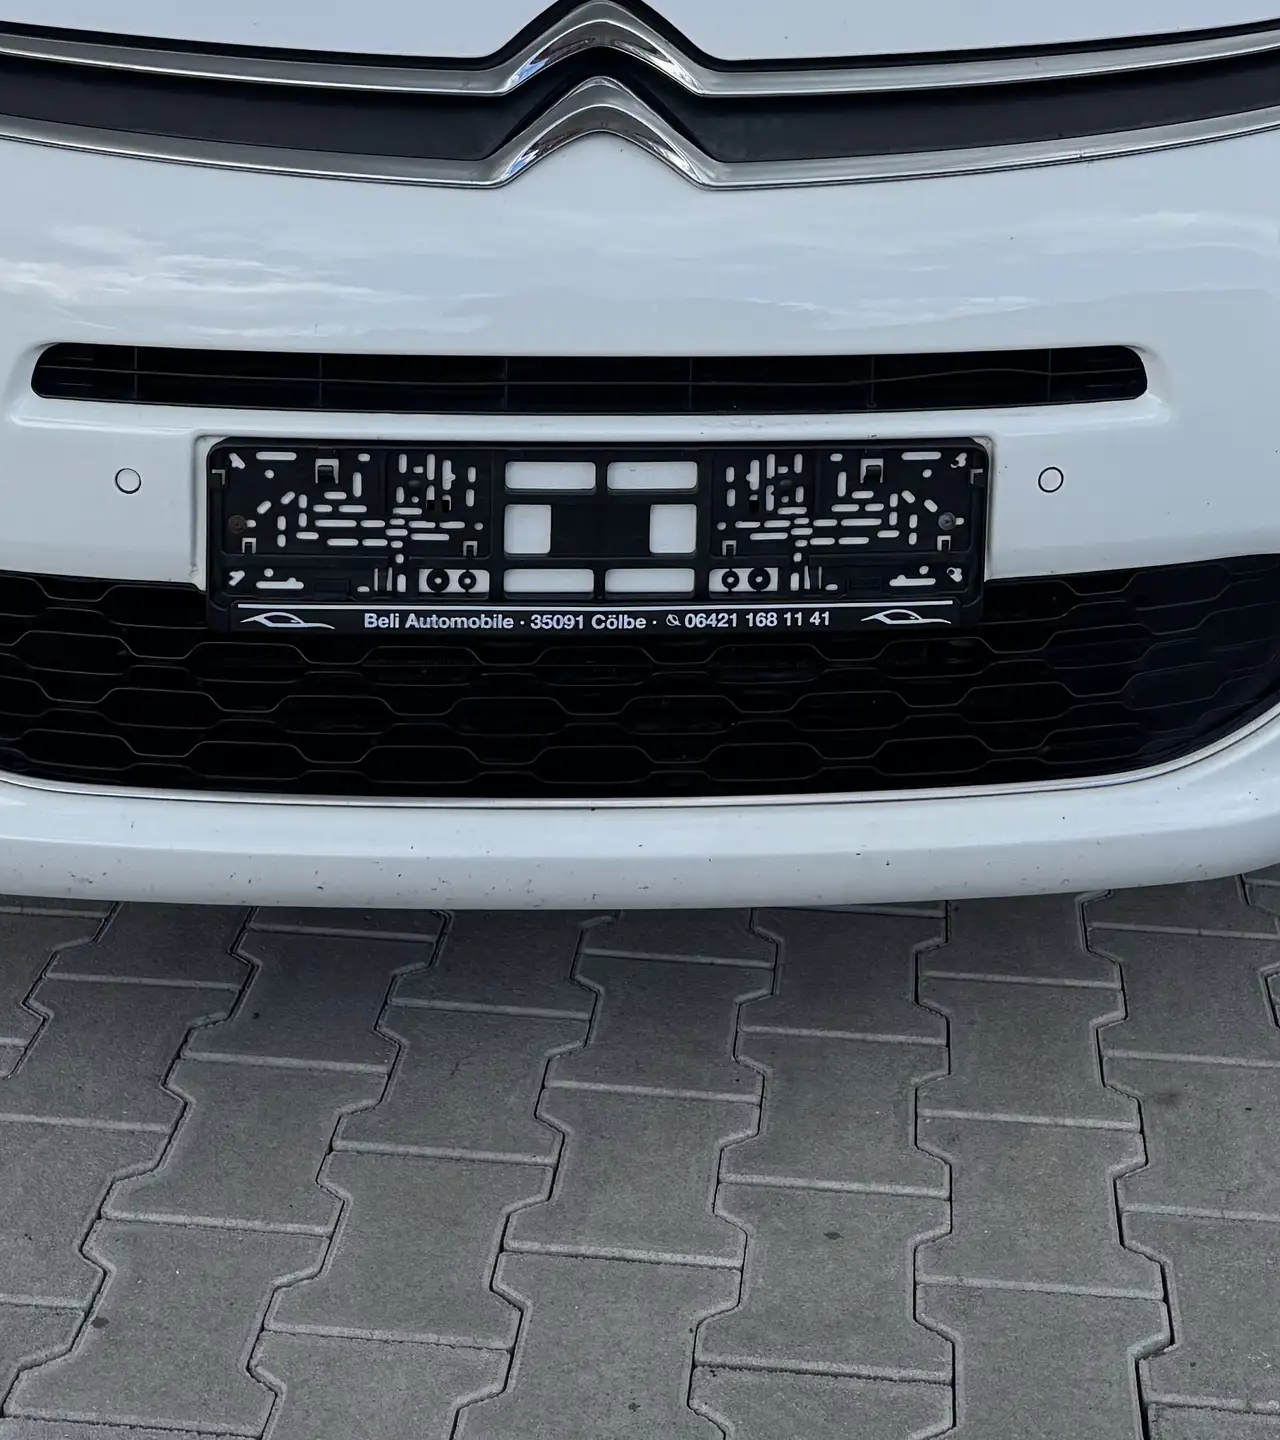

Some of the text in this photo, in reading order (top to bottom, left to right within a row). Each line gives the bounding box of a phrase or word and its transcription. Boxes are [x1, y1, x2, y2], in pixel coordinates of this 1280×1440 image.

[364, 611, 830, 630] Beli Automobile 35091 Cölbe 06421 168 11 41
